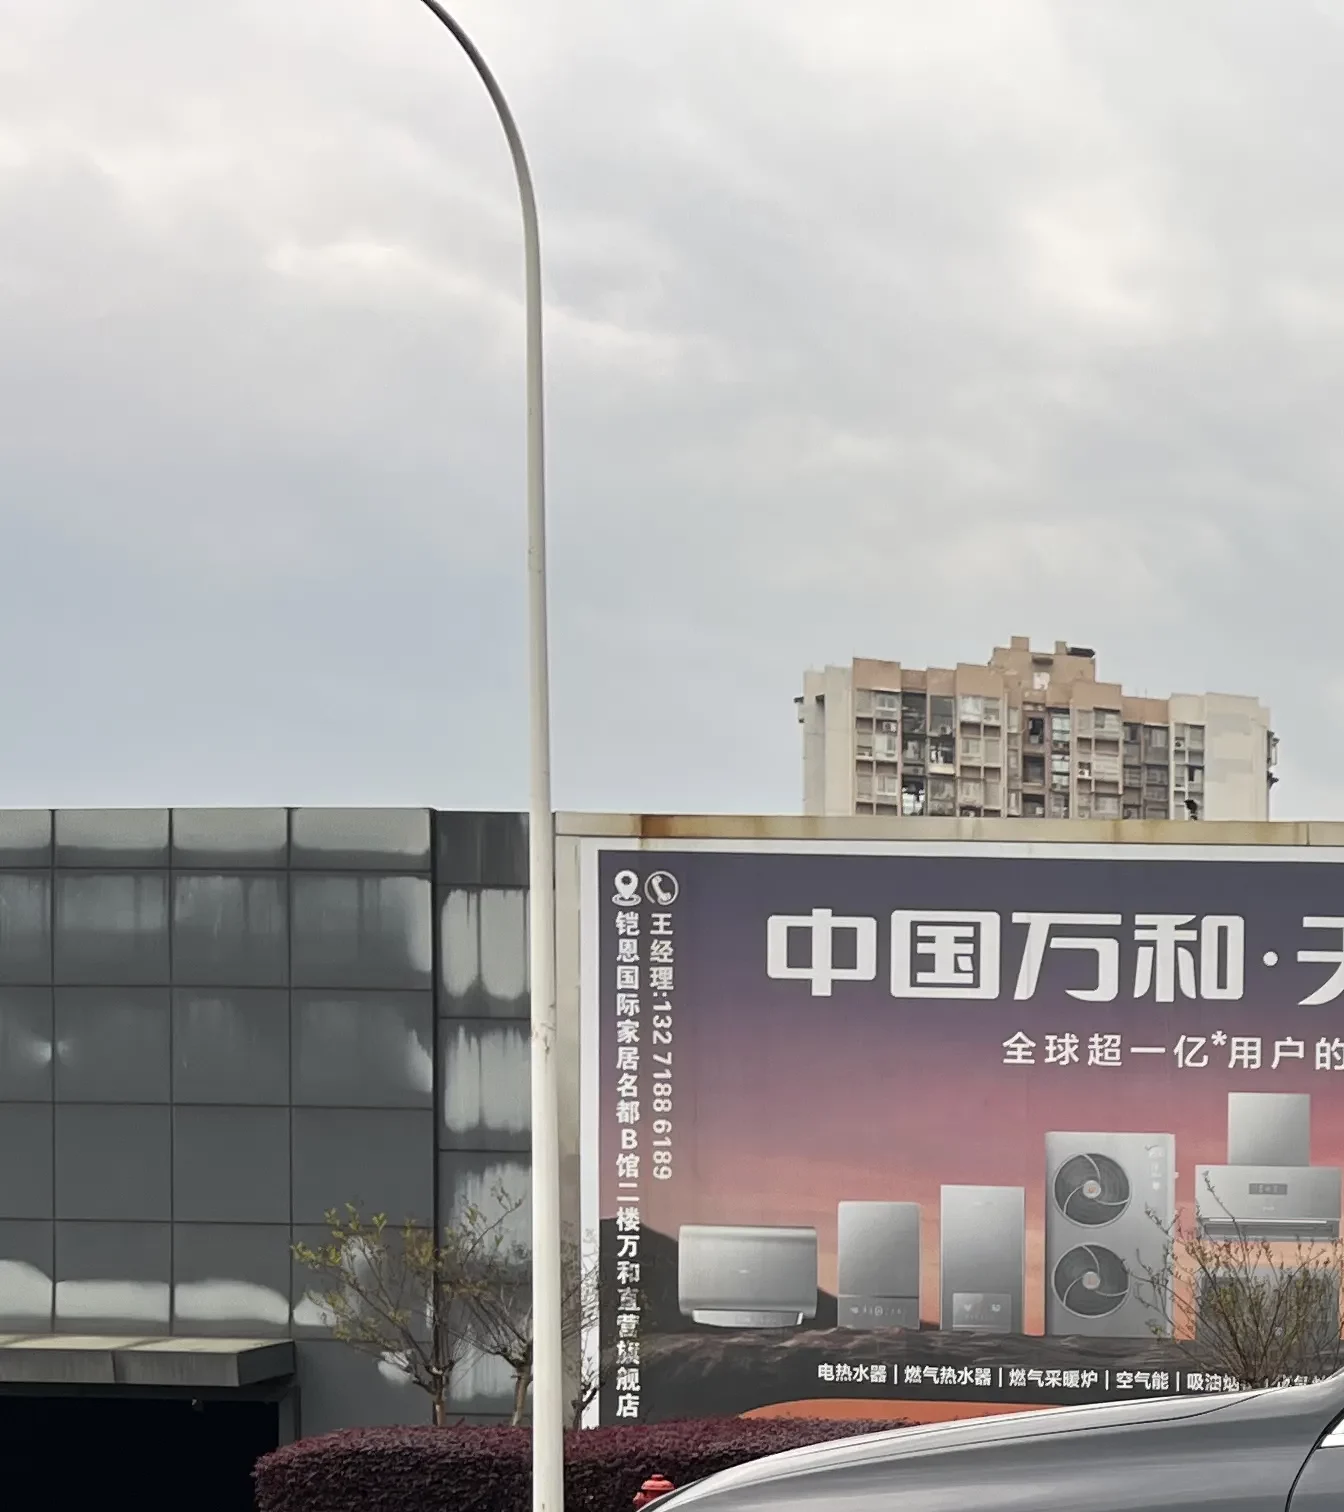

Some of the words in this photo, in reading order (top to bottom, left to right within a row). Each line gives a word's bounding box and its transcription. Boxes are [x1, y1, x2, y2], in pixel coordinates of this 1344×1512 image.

[652, 1051, 673, 1113] 7188
[652, 1119, 673, 1180] 6189
[817, 1363, 887, 1384] 电热水器
[904, 1365, 992, 1387] 燃气热水器
[1008, 1368, 1098, 1389] 燃气采暖炉
[1116, 1370, 1169, 1391] 空气能
